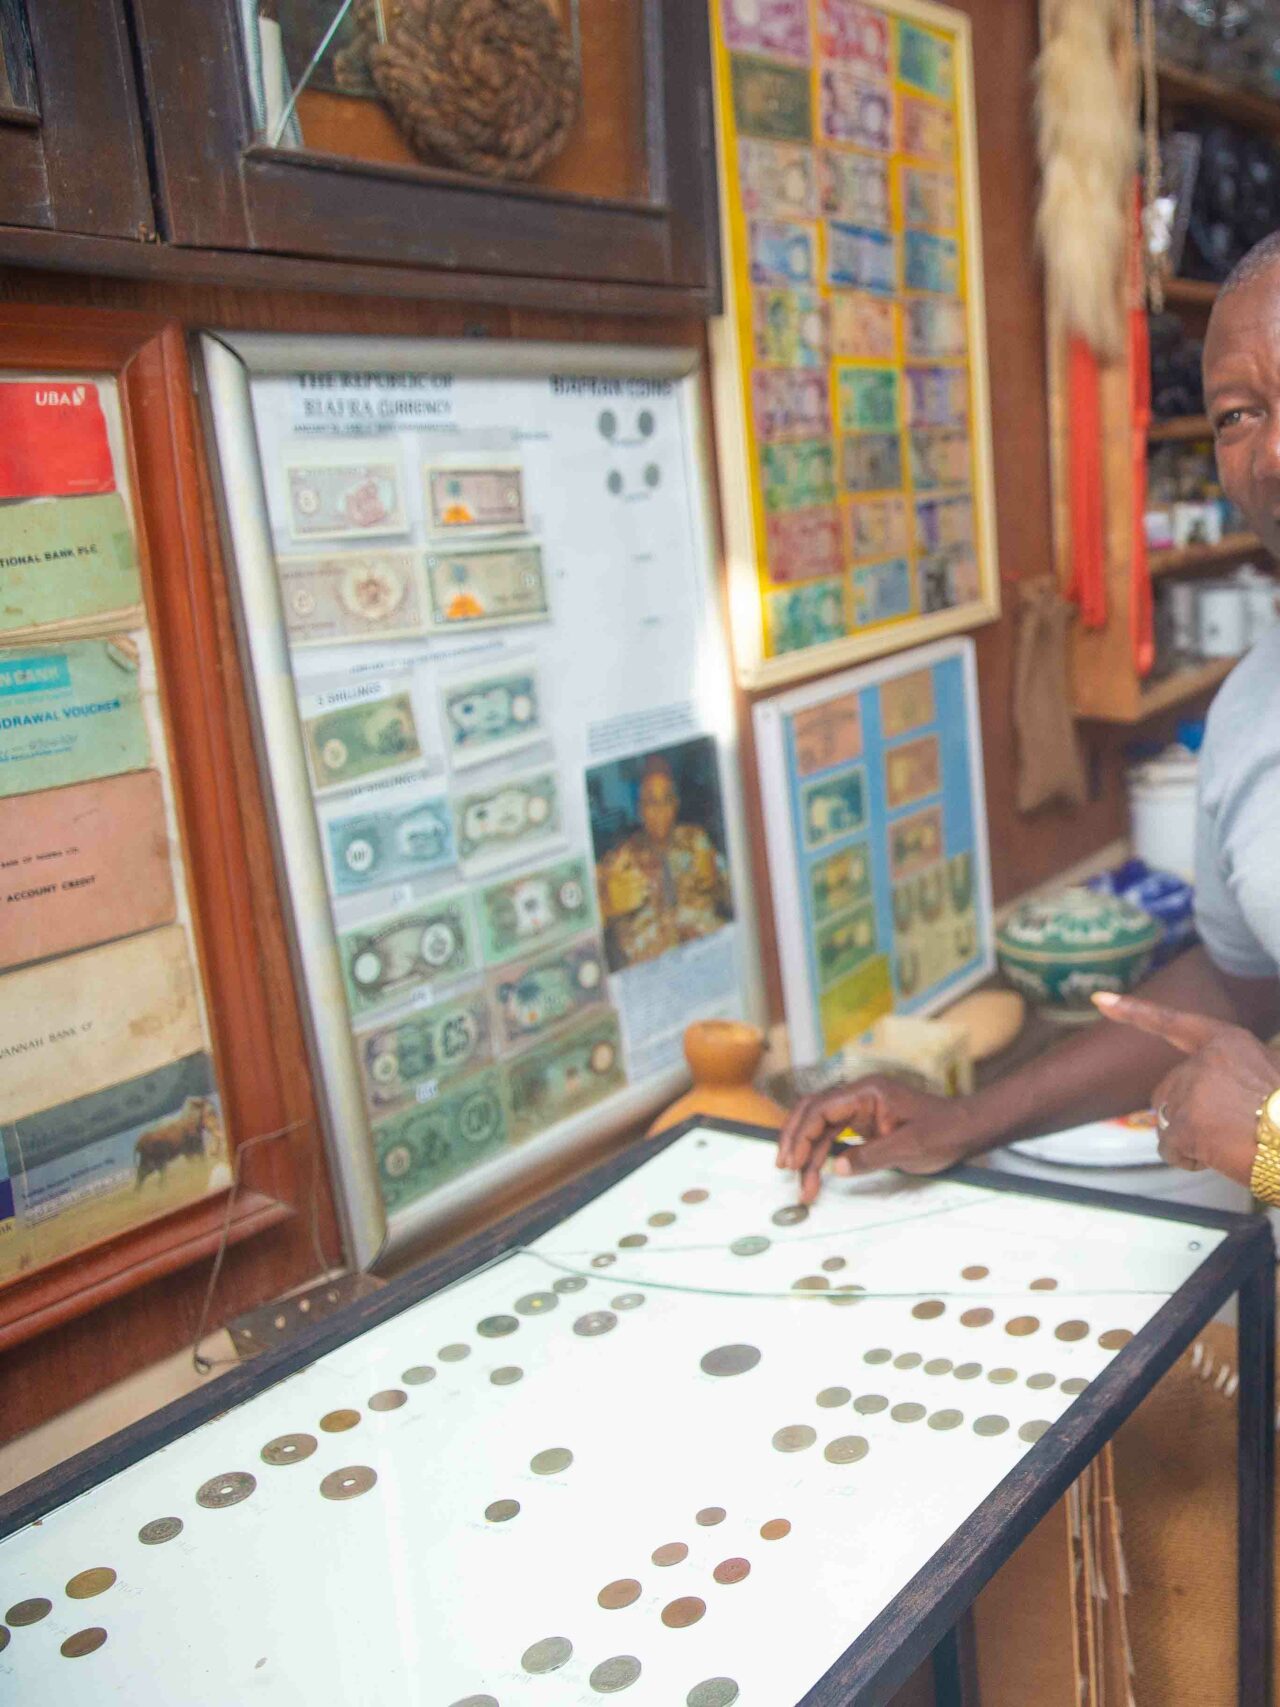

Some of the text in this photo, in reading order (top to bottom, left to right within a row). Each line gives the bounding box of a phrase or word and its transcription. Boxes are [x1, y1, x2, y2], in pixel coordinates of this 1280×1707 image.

[35, 390, 71, 406] UBA
[44, 548, 75, 561] BANK
[62, 699, 121, 719] VOUCHER
[7, 883, 57, 903] ACCOUNT
